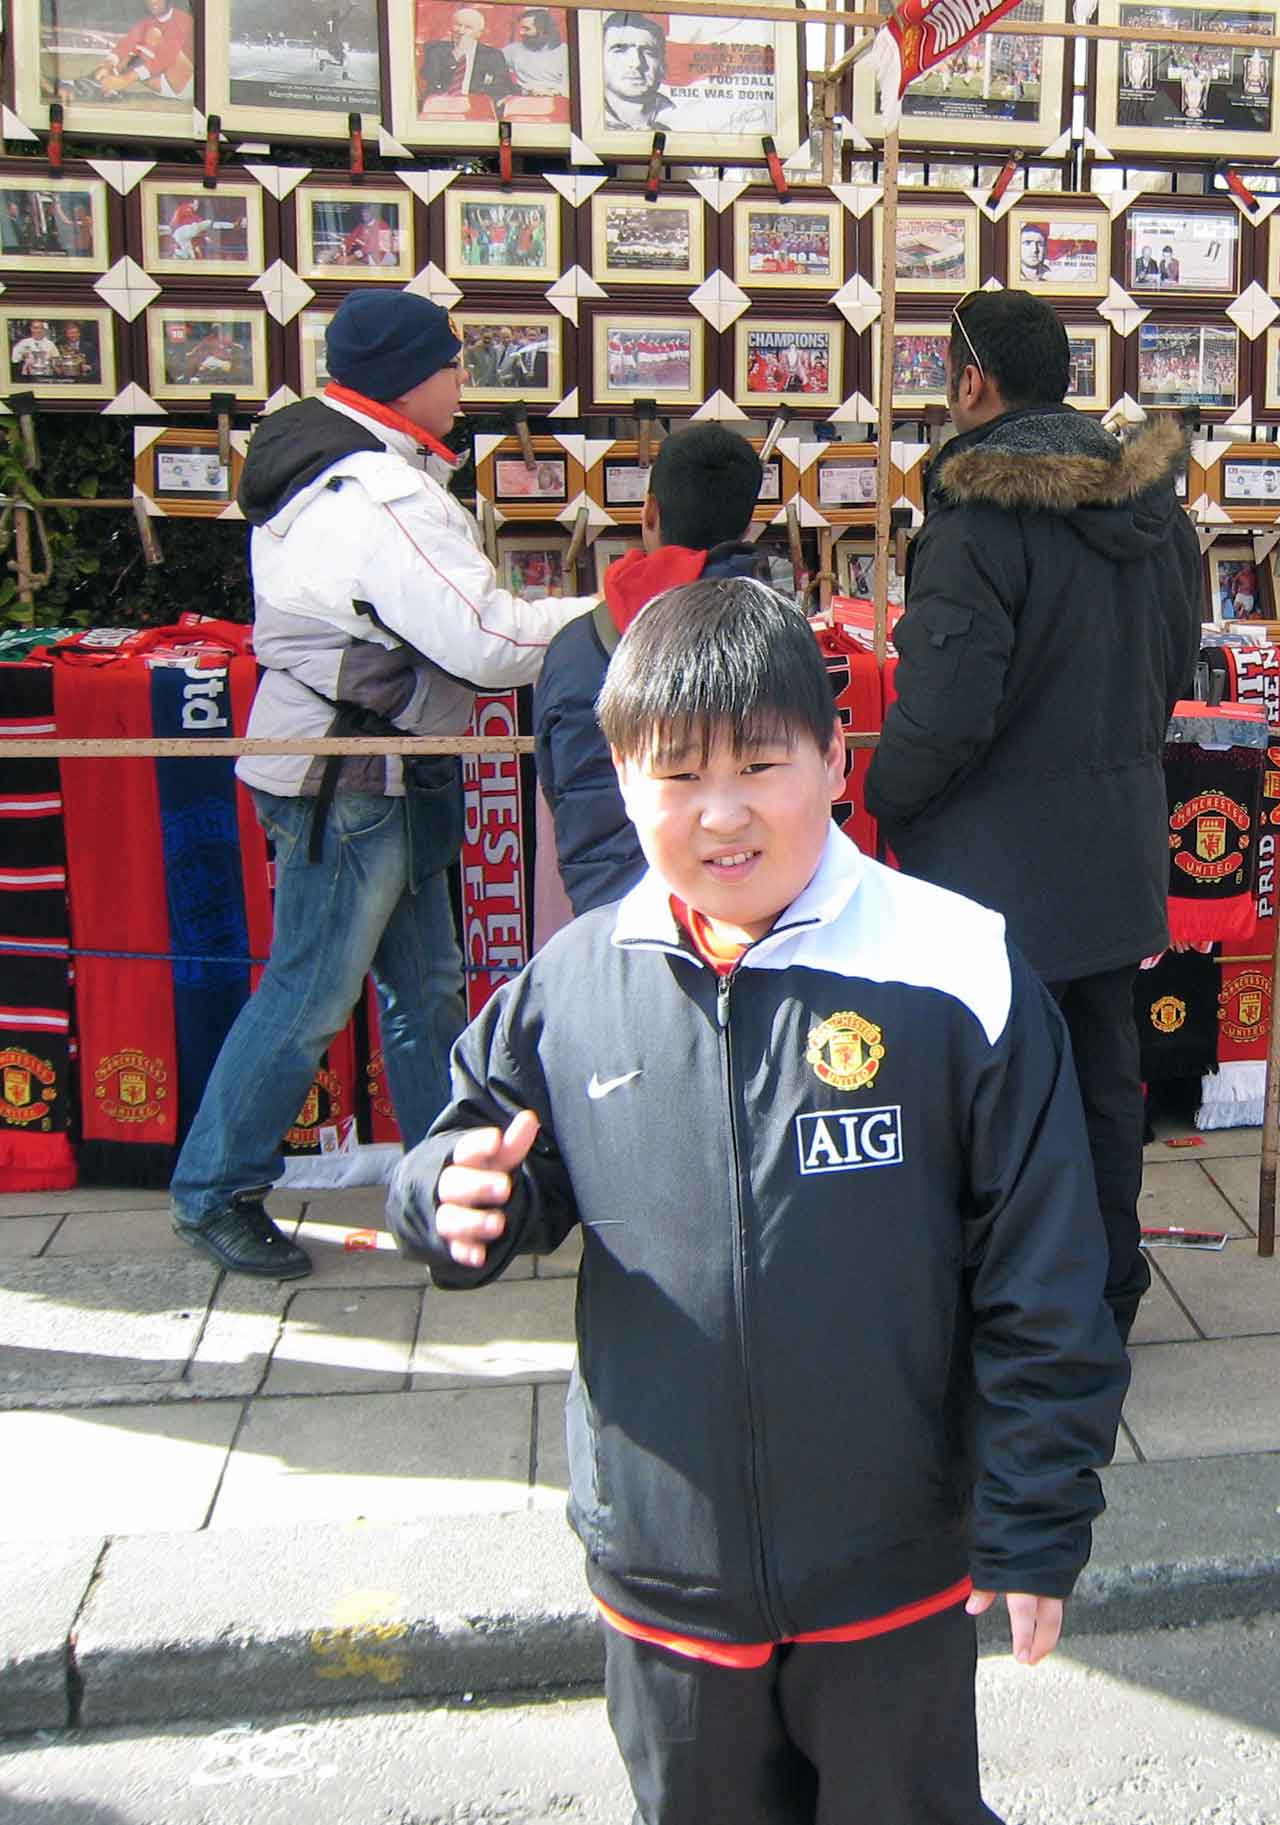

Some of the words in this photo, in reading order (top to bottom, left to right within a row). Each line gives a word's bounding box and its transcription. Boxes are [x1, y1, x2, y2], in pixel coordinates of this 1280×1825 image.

[708, 75, 775, 87] FOOTBALL
[670, 87, 700, 98] ERIC
[704, 88, 735, 100] WAS
[748, 332, 829, 349] CHAMPIONS!
[1173, 795, 1246, 825] MANCHESTER
[1185, 861, 1234, 876] UNITED
[806, 1112, 897, 1167] AIG
